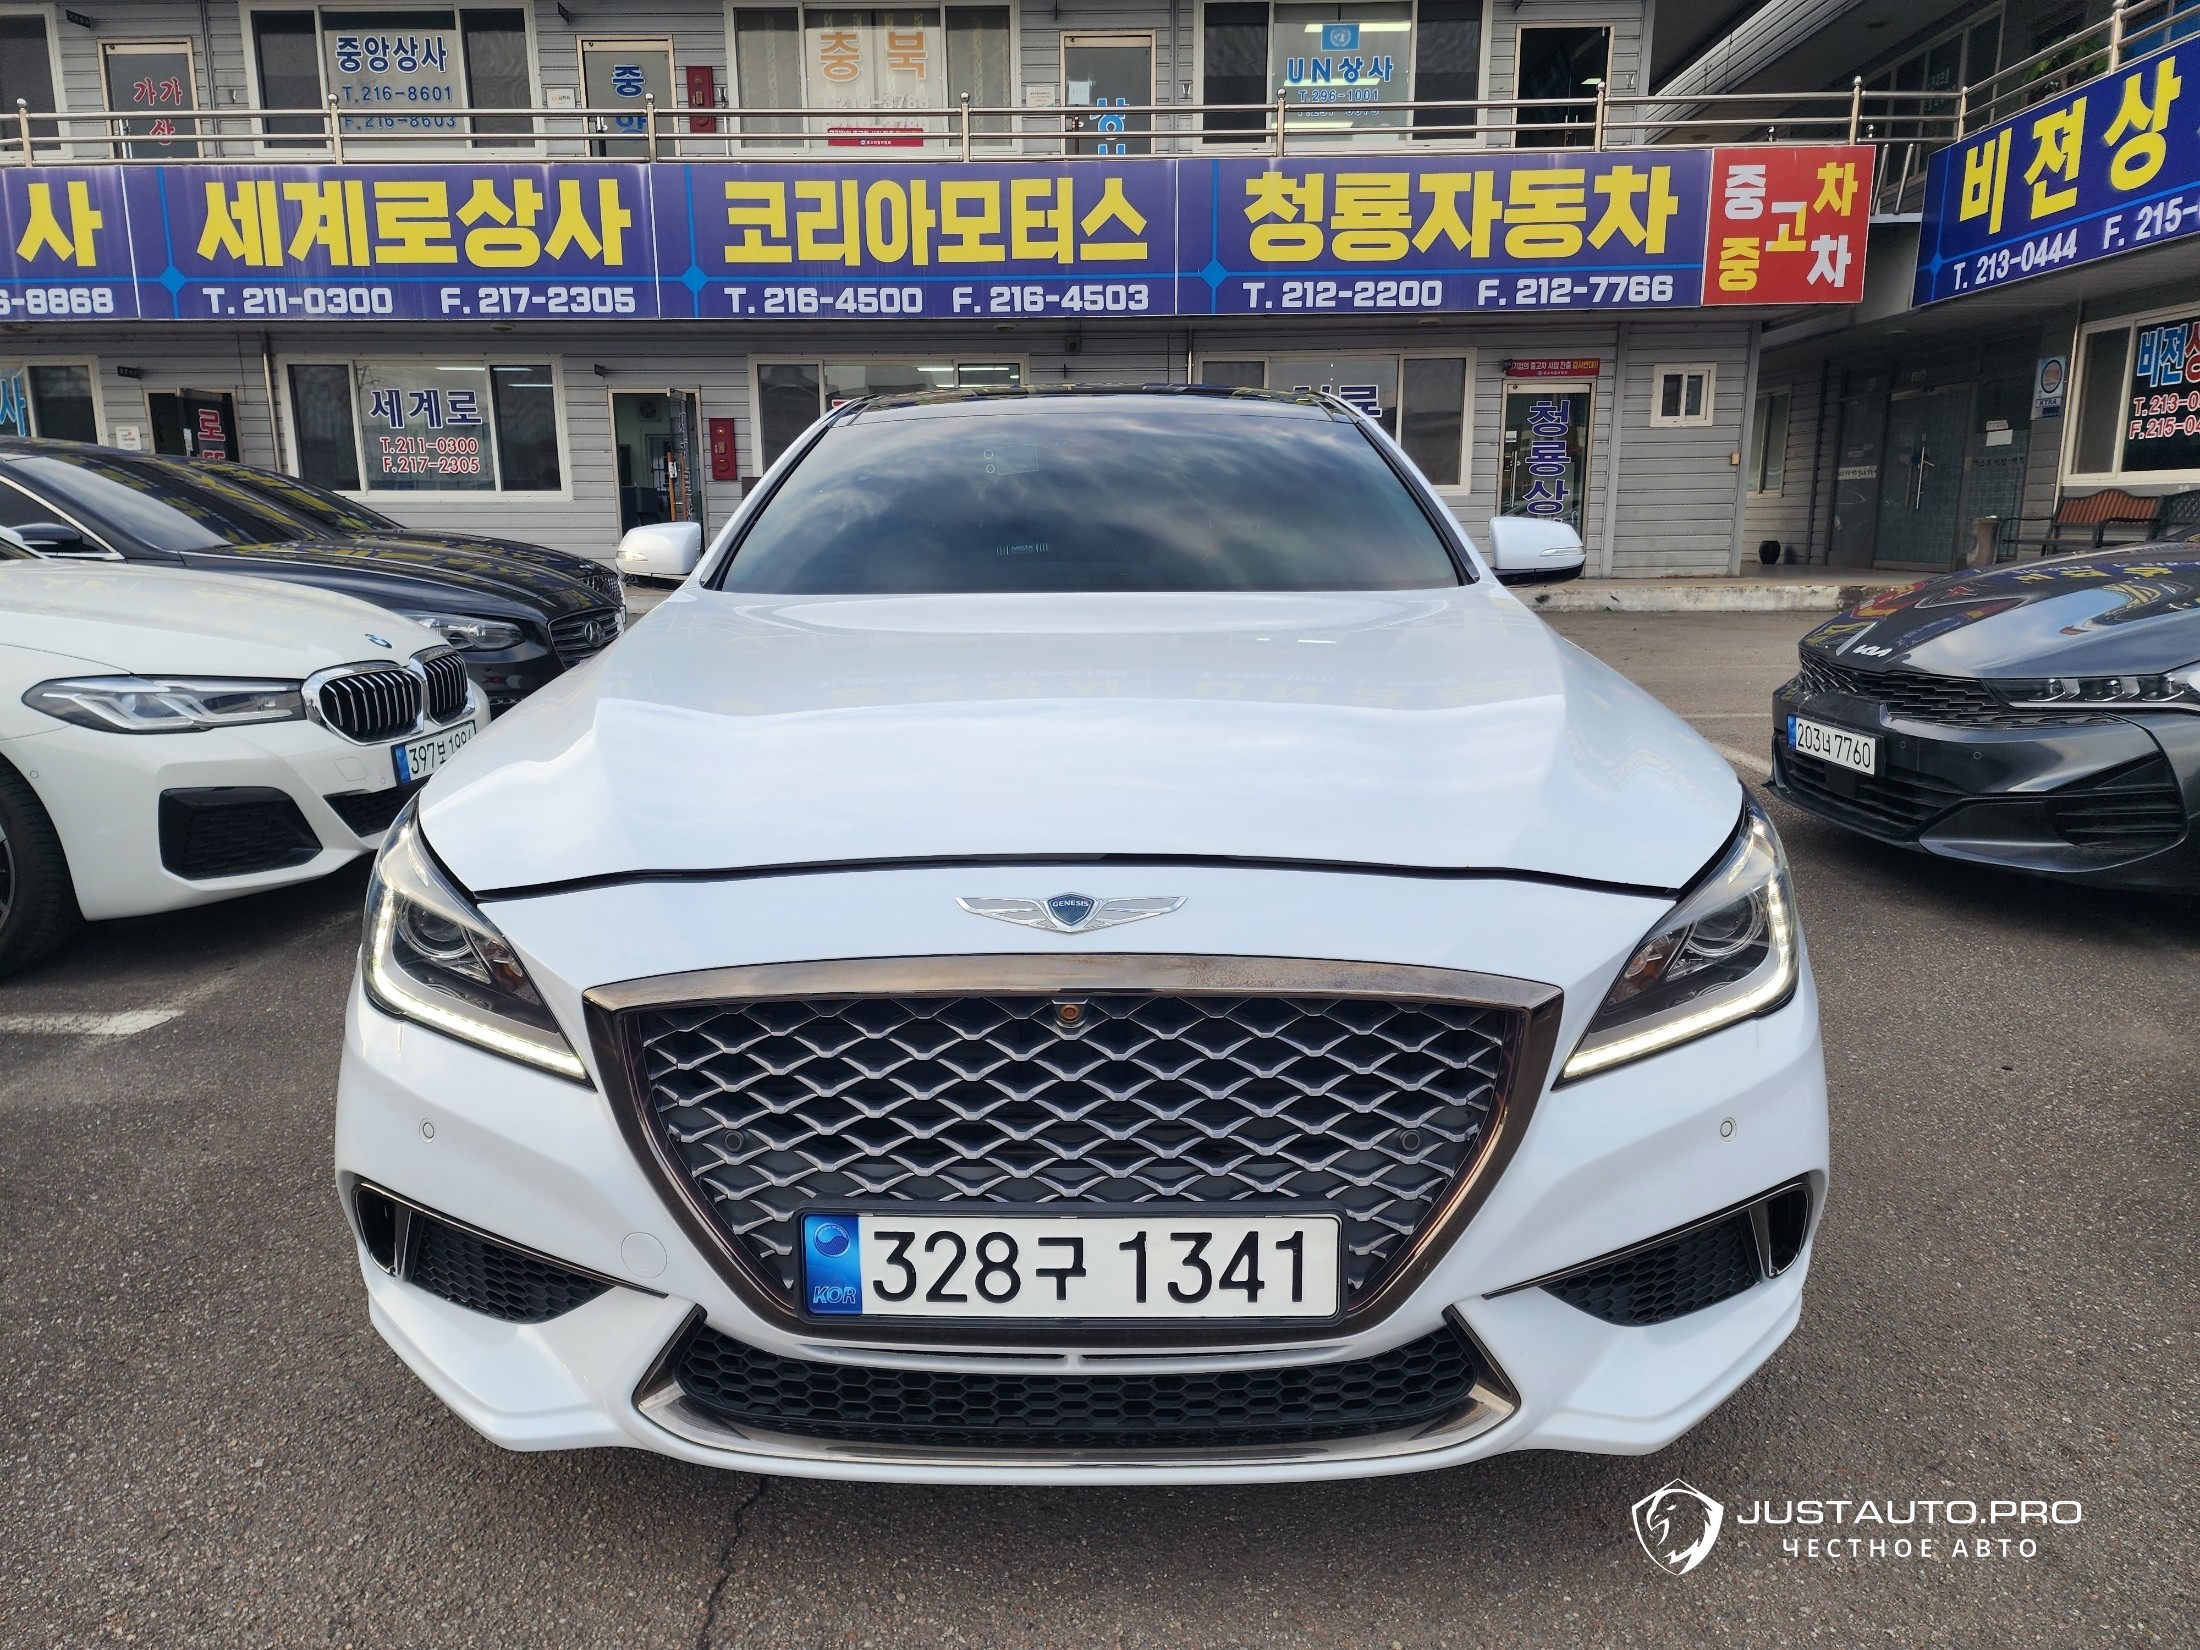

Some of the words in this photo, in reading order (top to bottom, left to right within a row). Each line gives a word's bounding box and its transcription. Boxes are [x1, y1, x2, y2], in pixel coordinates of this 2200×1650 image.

[336, 35, 448, 73] 중앙상사
[1287, 57, 1332, 84] UN
[1338, 56, 1394, 83] 상사
[133, 77, 183, 105] 가가
[342, 85, 454, 103] T.216-8601
[1298, 89, 1379, 102] T.296-1001
[16, 181, 103, 267] 사
[197, 180, 632, 268] 세계로상사
[724, 178, 1148, 266] 코리아모터스
[1244, 166, 1678, 262] 청룡자동차
[2102, 215, 2126, 251] F.
[2134, 196, 2200, 242] 215-
[1953, 262, 1969, 291] T.
[1975, 228, 2078, 286] 213-0444
[202, 288, 236, 315] T.
[243, 288, 394, 314] 211-0300
[440, 287, 471, 314] F.
[478, 287, 636, 314] 217-2305
[723, 288, 757, 314] T.
[764, 287, 923, 314] 216-4500
[952, 286, 982, 313] F.
[990, 285, 1150, 314] 216-4503
[1242, 281, 1274, 309] T.
[1281, 280, 1443, 309] 212-2200
[1477, 279, 1507, 307] F.
[1515, 275, 1674, 306] 212-7766
[369, 388, 483, 429] 세계로
[2133, 391, 2200, 417] T.213-0
[380, 437, 479, 454] T.211-0300
[383, 456, 481, 474] F.217-2305
[1523, 400, 1571, 523] 청룡상
[1853, 644, 1893, 658] KIA
[1798, 723, 1832, 756] 203너
[1834, 733, 1871, 768] 7760
[1052, 900, 1089, 908] GENESIS
[872, 1230, 1087, 1303] 328구
[1118, 1230, 1304, 1304] 1341
[813, 1286, 857, 1304] KOR
